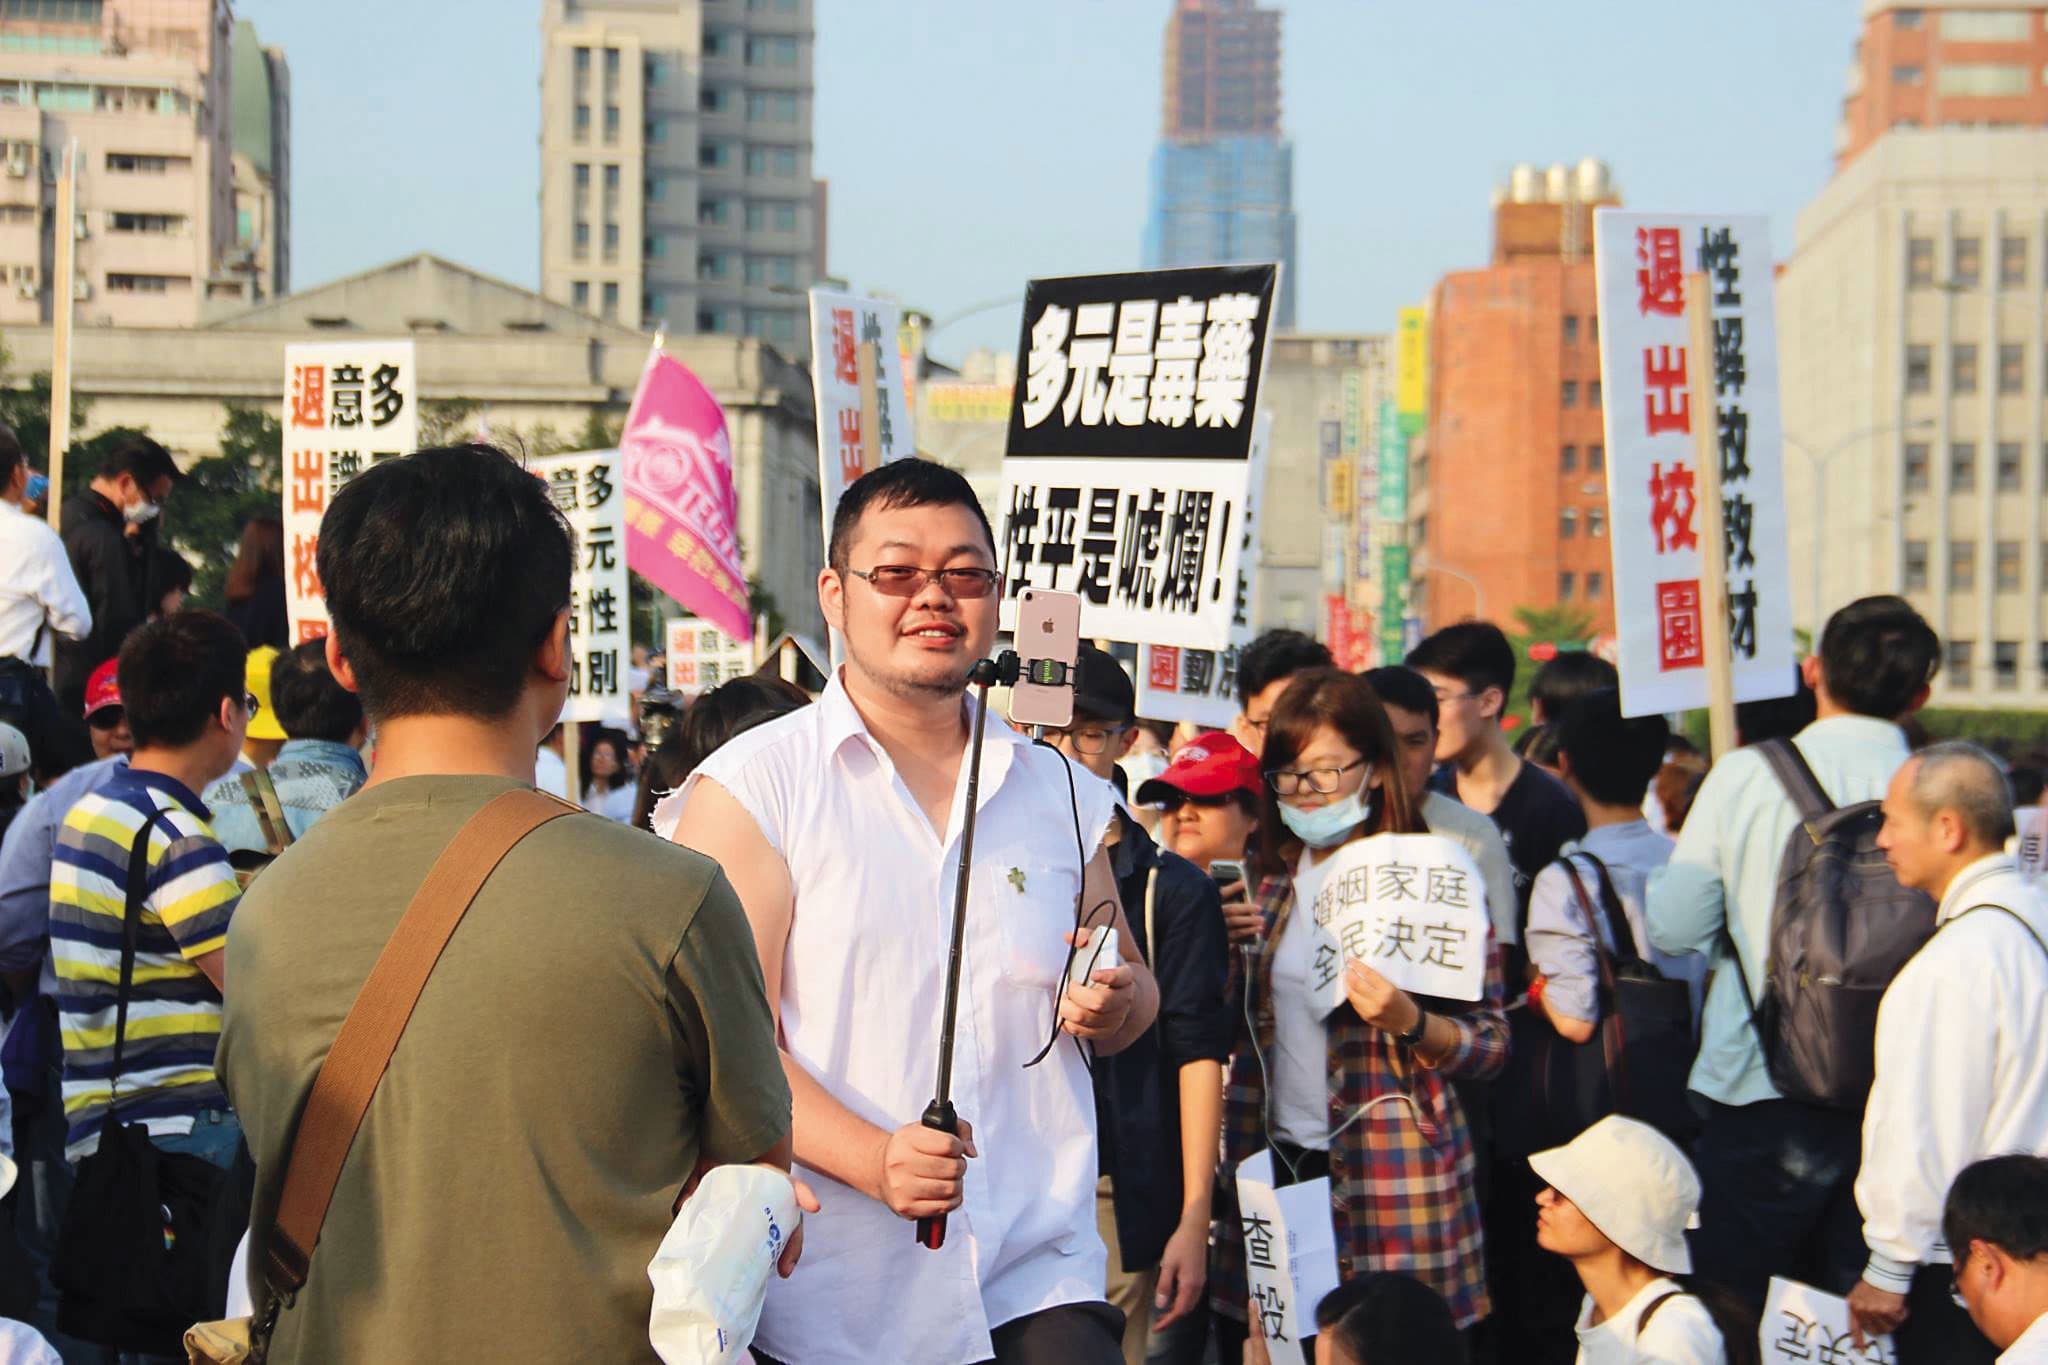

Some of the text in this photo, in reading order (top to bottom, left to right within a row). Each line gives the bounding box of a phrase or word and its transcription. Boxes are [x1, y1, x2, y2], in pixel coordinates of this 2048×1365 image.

[371, 363, 403, 461] 多
[1022, 293, 1260, 429] 多元是毒藥
[1636, 226, 1704, 673] 退出校園
[585, 465, 618, 694] 多元性別
[1312, 861, 1469, 936] 婚姻家庭
[1312, 916, 1466, 992] 全民決定
